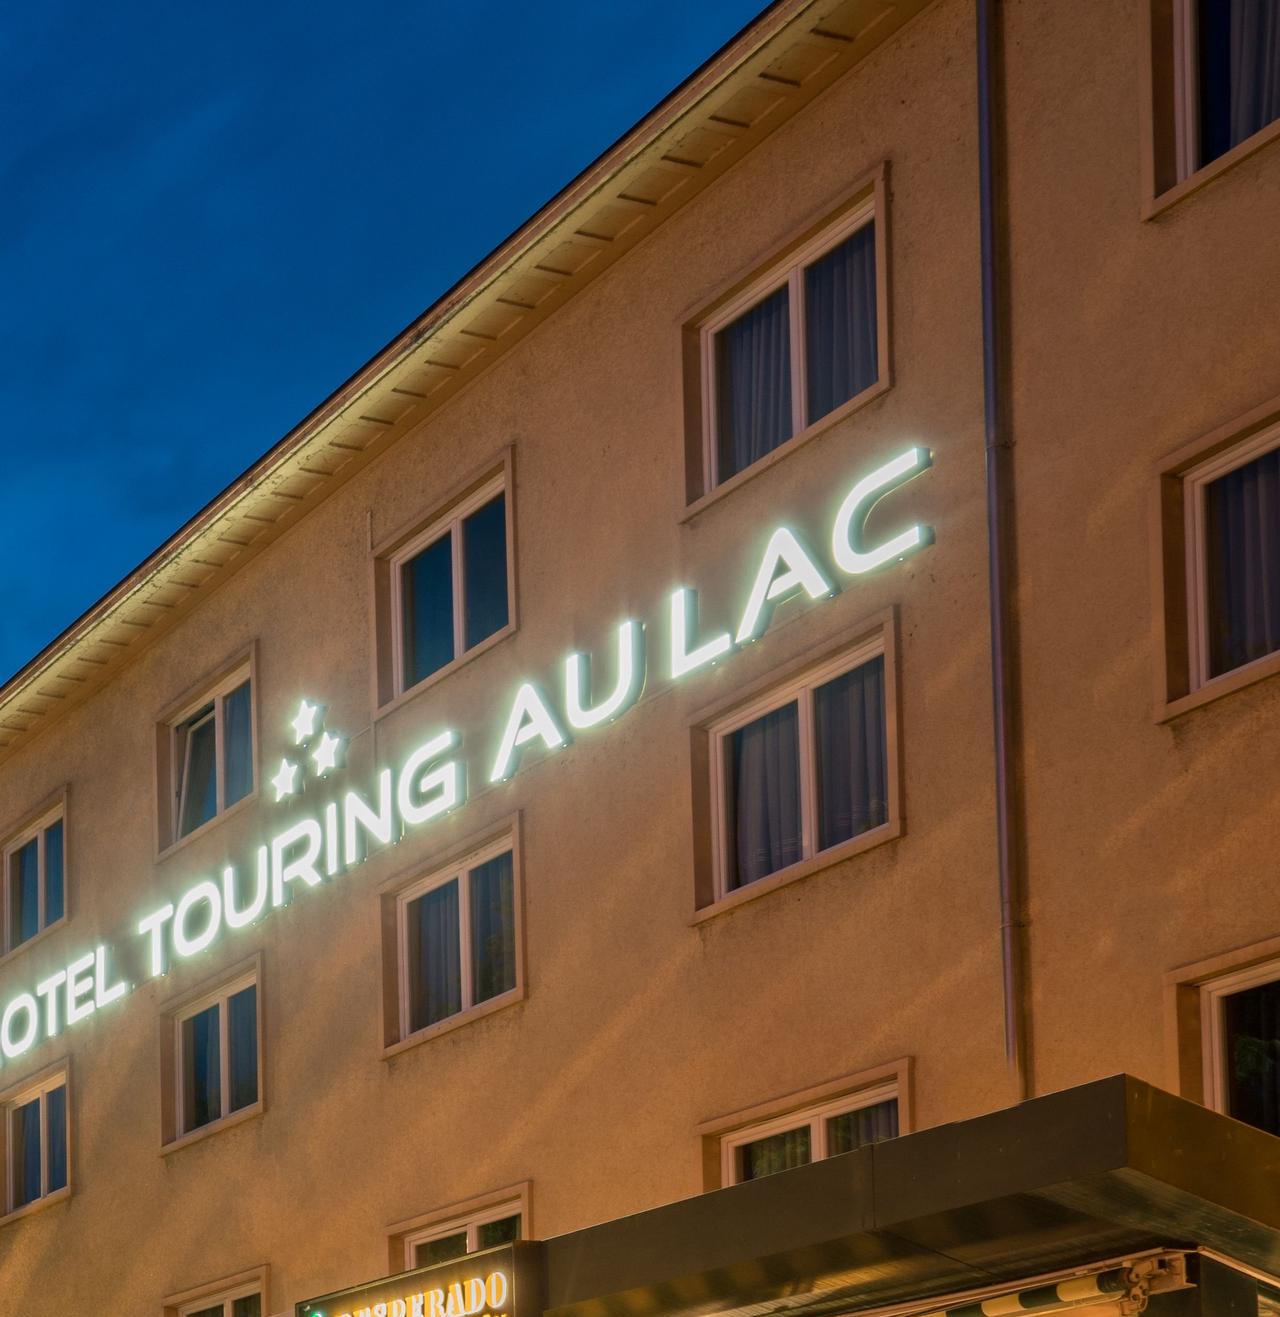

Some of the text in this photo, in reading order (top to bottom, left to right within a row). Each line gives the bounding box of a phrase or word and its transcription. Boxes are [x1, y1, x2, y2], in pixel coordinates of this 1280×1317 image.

[139, 730, 462, 978] TOURING
[490, 620, 644, 783] AU
[668, 446, 934, 677] LAC
